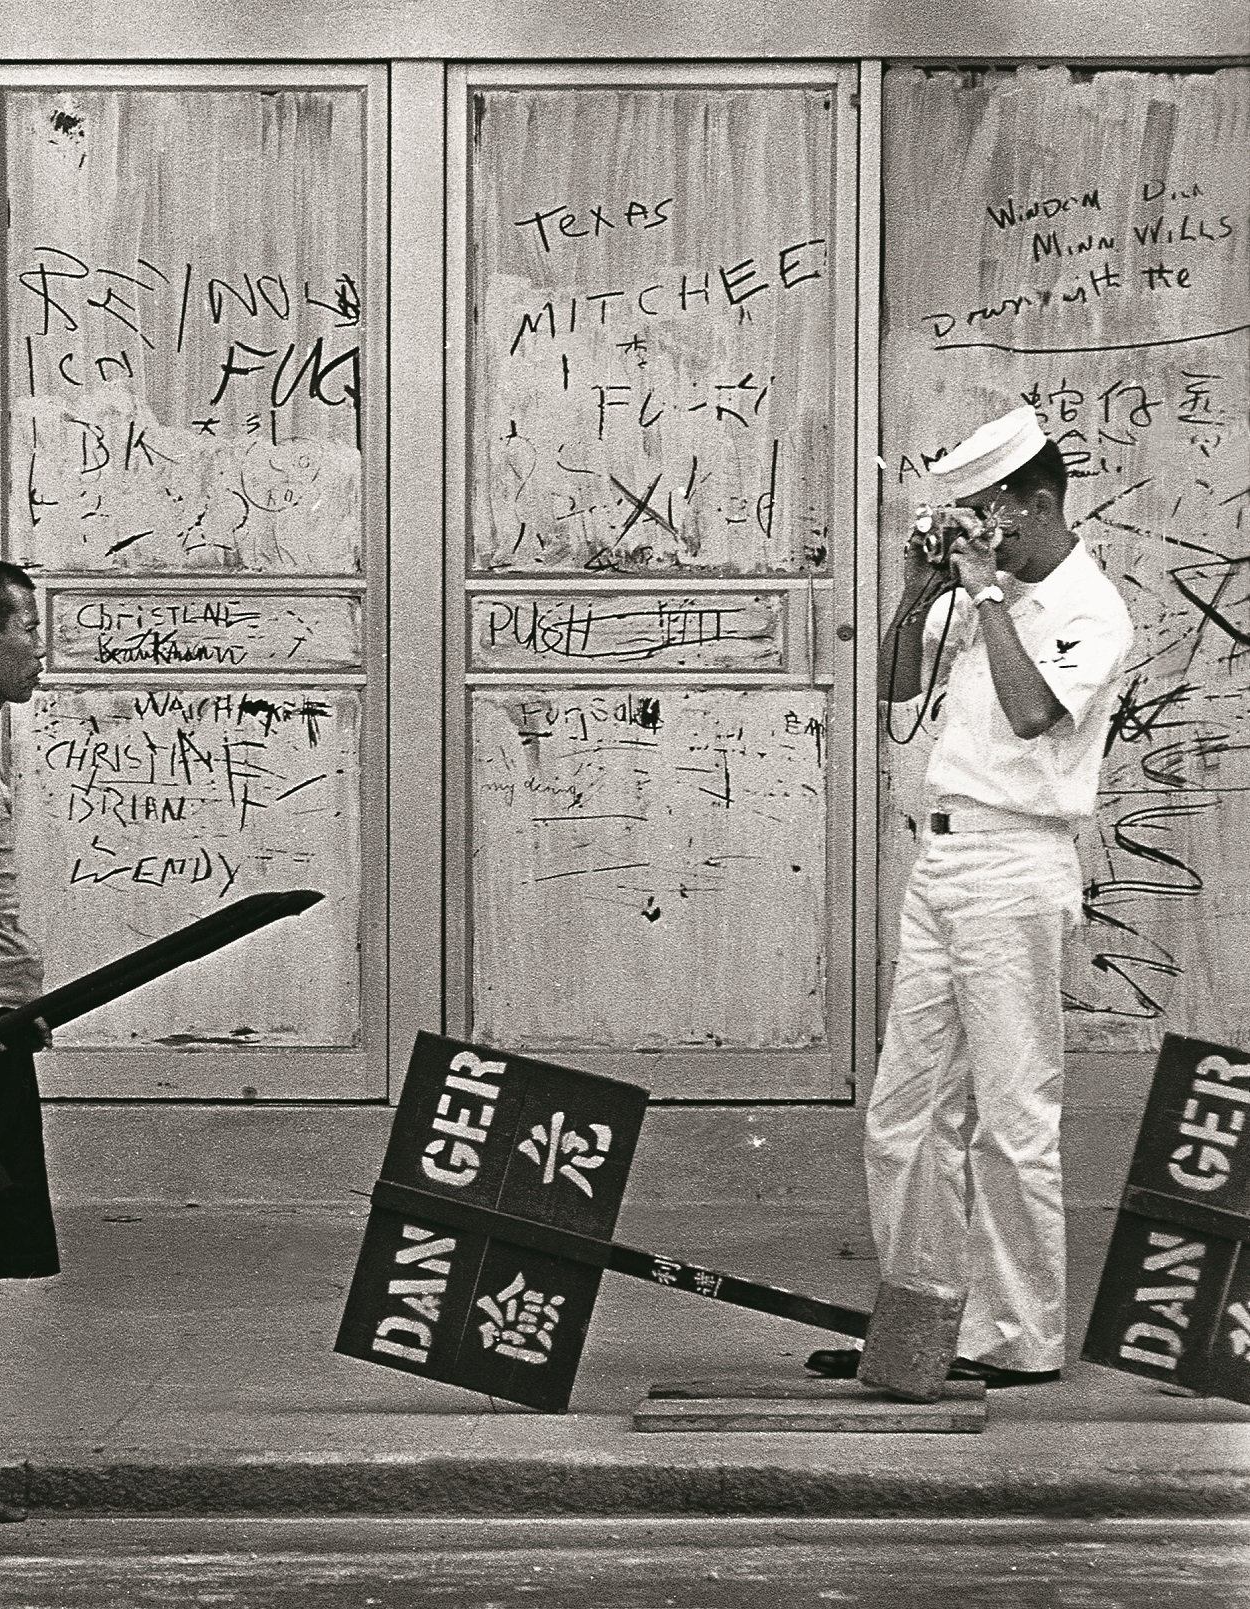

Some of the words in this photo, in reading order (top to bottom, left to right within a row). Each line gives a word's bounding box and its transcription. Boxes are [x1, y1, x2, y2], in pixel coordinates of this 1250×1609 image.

[371, 1222, 457, 1364] DAN
[420, 1050, 508, 1187] GER
[1118, 1231, 1206, 1371] DAN
[1167, 1054, 1250, 1192] GER
